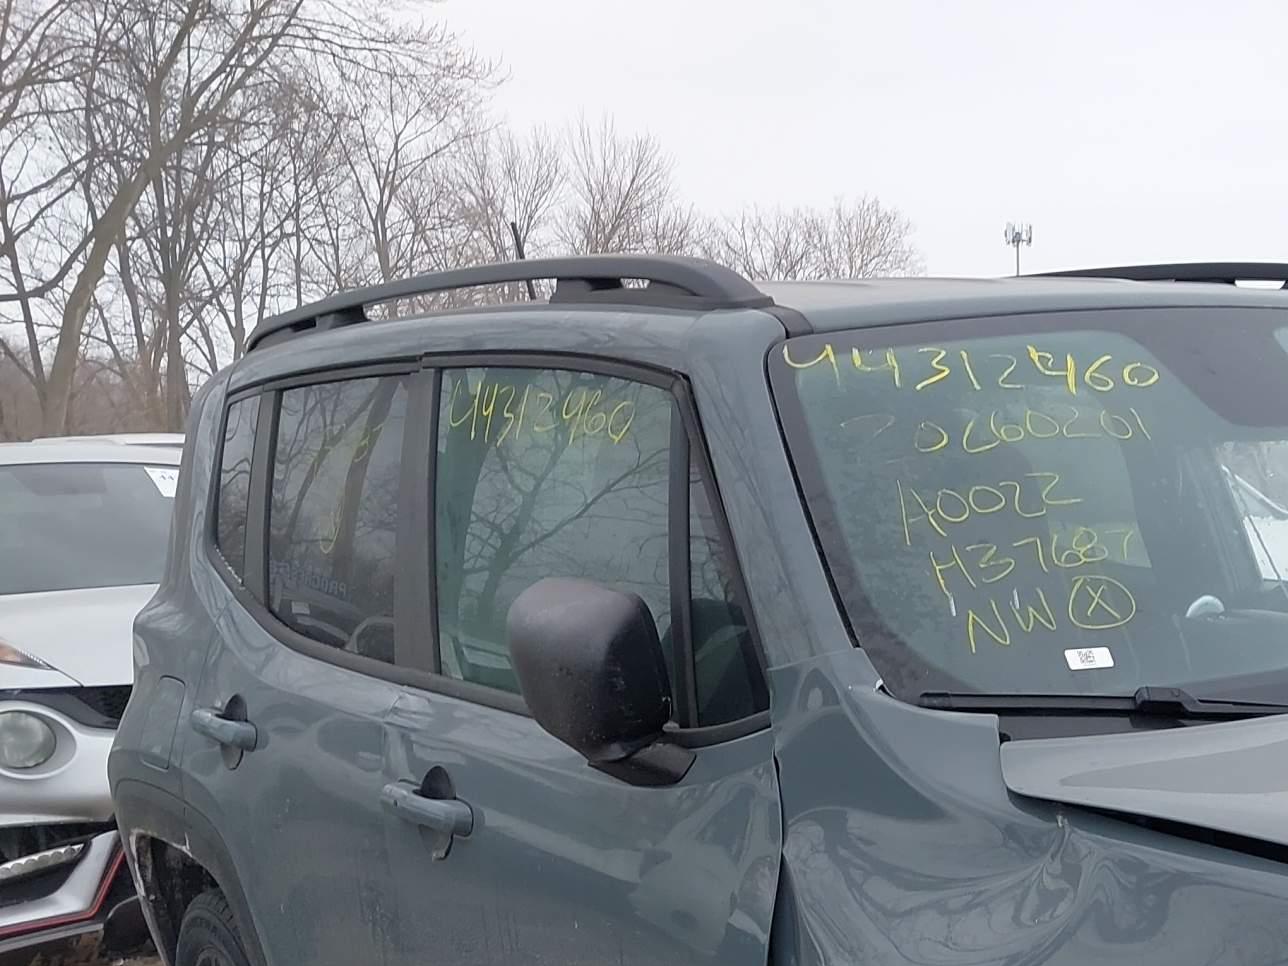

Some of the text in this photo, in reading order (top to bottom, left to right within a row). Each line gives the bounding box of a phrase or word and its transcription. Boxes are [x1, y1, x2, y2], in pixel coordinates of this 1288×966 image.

[783, 344, 1160, 395] 44312460
[449, 378, 636, 448] 44312460
[967, 586, 1057, 654] NW
